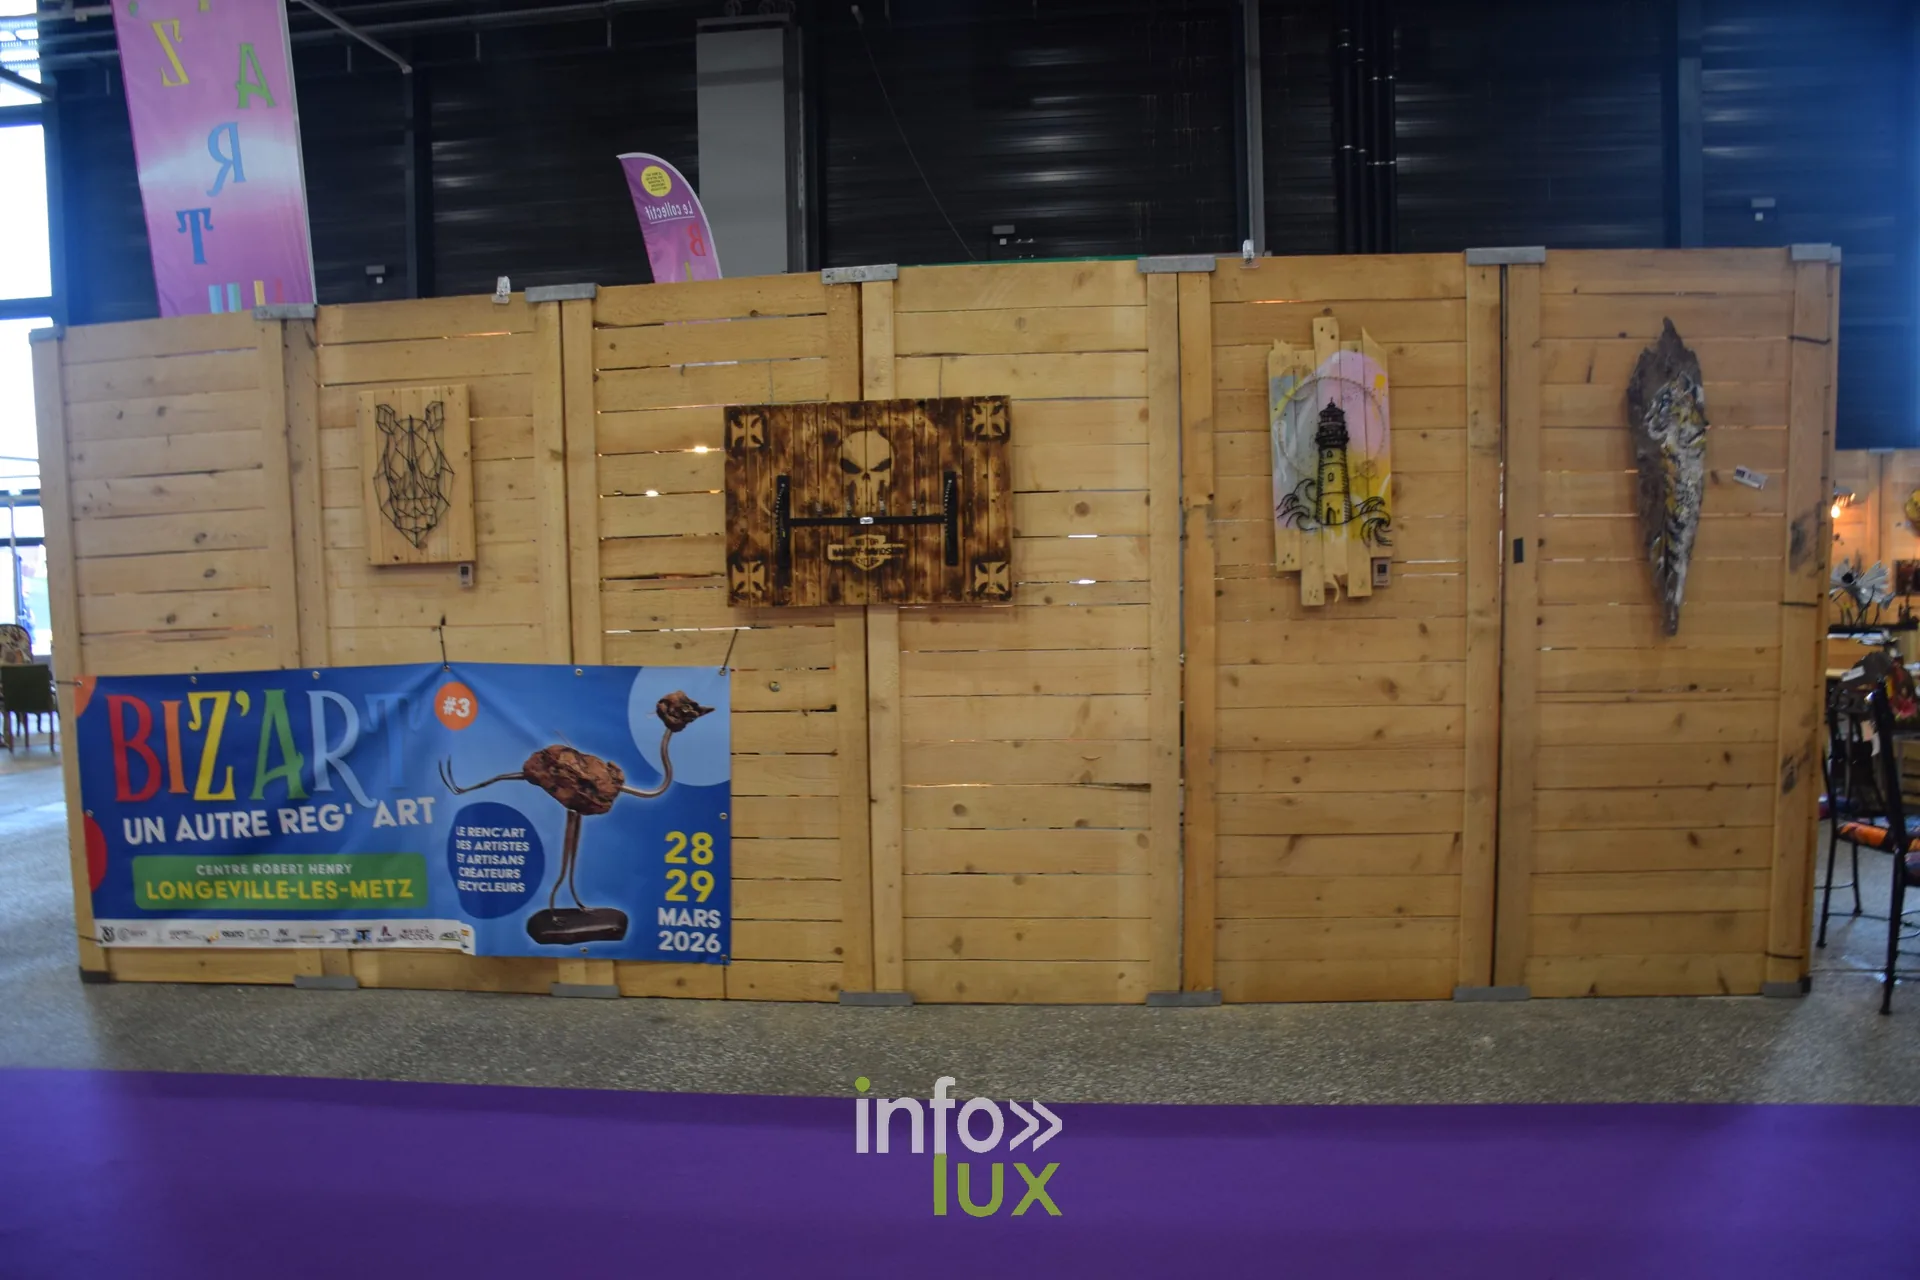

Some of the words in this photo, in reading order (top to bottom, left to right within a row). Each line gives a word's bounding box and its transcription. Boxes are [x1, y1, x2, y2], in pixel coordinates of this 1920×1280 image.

[443, 695, 471, 718] #3
[105, 689, 428, 808] BIZ'ART
[123, 816, 167, 845] UN
[175, 809, 271, 842] AUTRE
[278, 803, 353, 834] REG'
[372, 797, 436, 828] ART
[474, 841, 530, 852] ARTISTES
[664, 830, 714, 866] 28
[196, 863, 249, 876] CENTRE
[252, 863, 304, 875] ROBERT
[308, 863, 353, 875] HENRY
[466, 854, 525, 866] ARTISANS
[146, 879, 414, 900] LONGEVILLE-LES-METZ
[664, 868, 716, 903] 29
[657, 907, 722, 929] MARS
[658, 930, 722, 954] 2026
